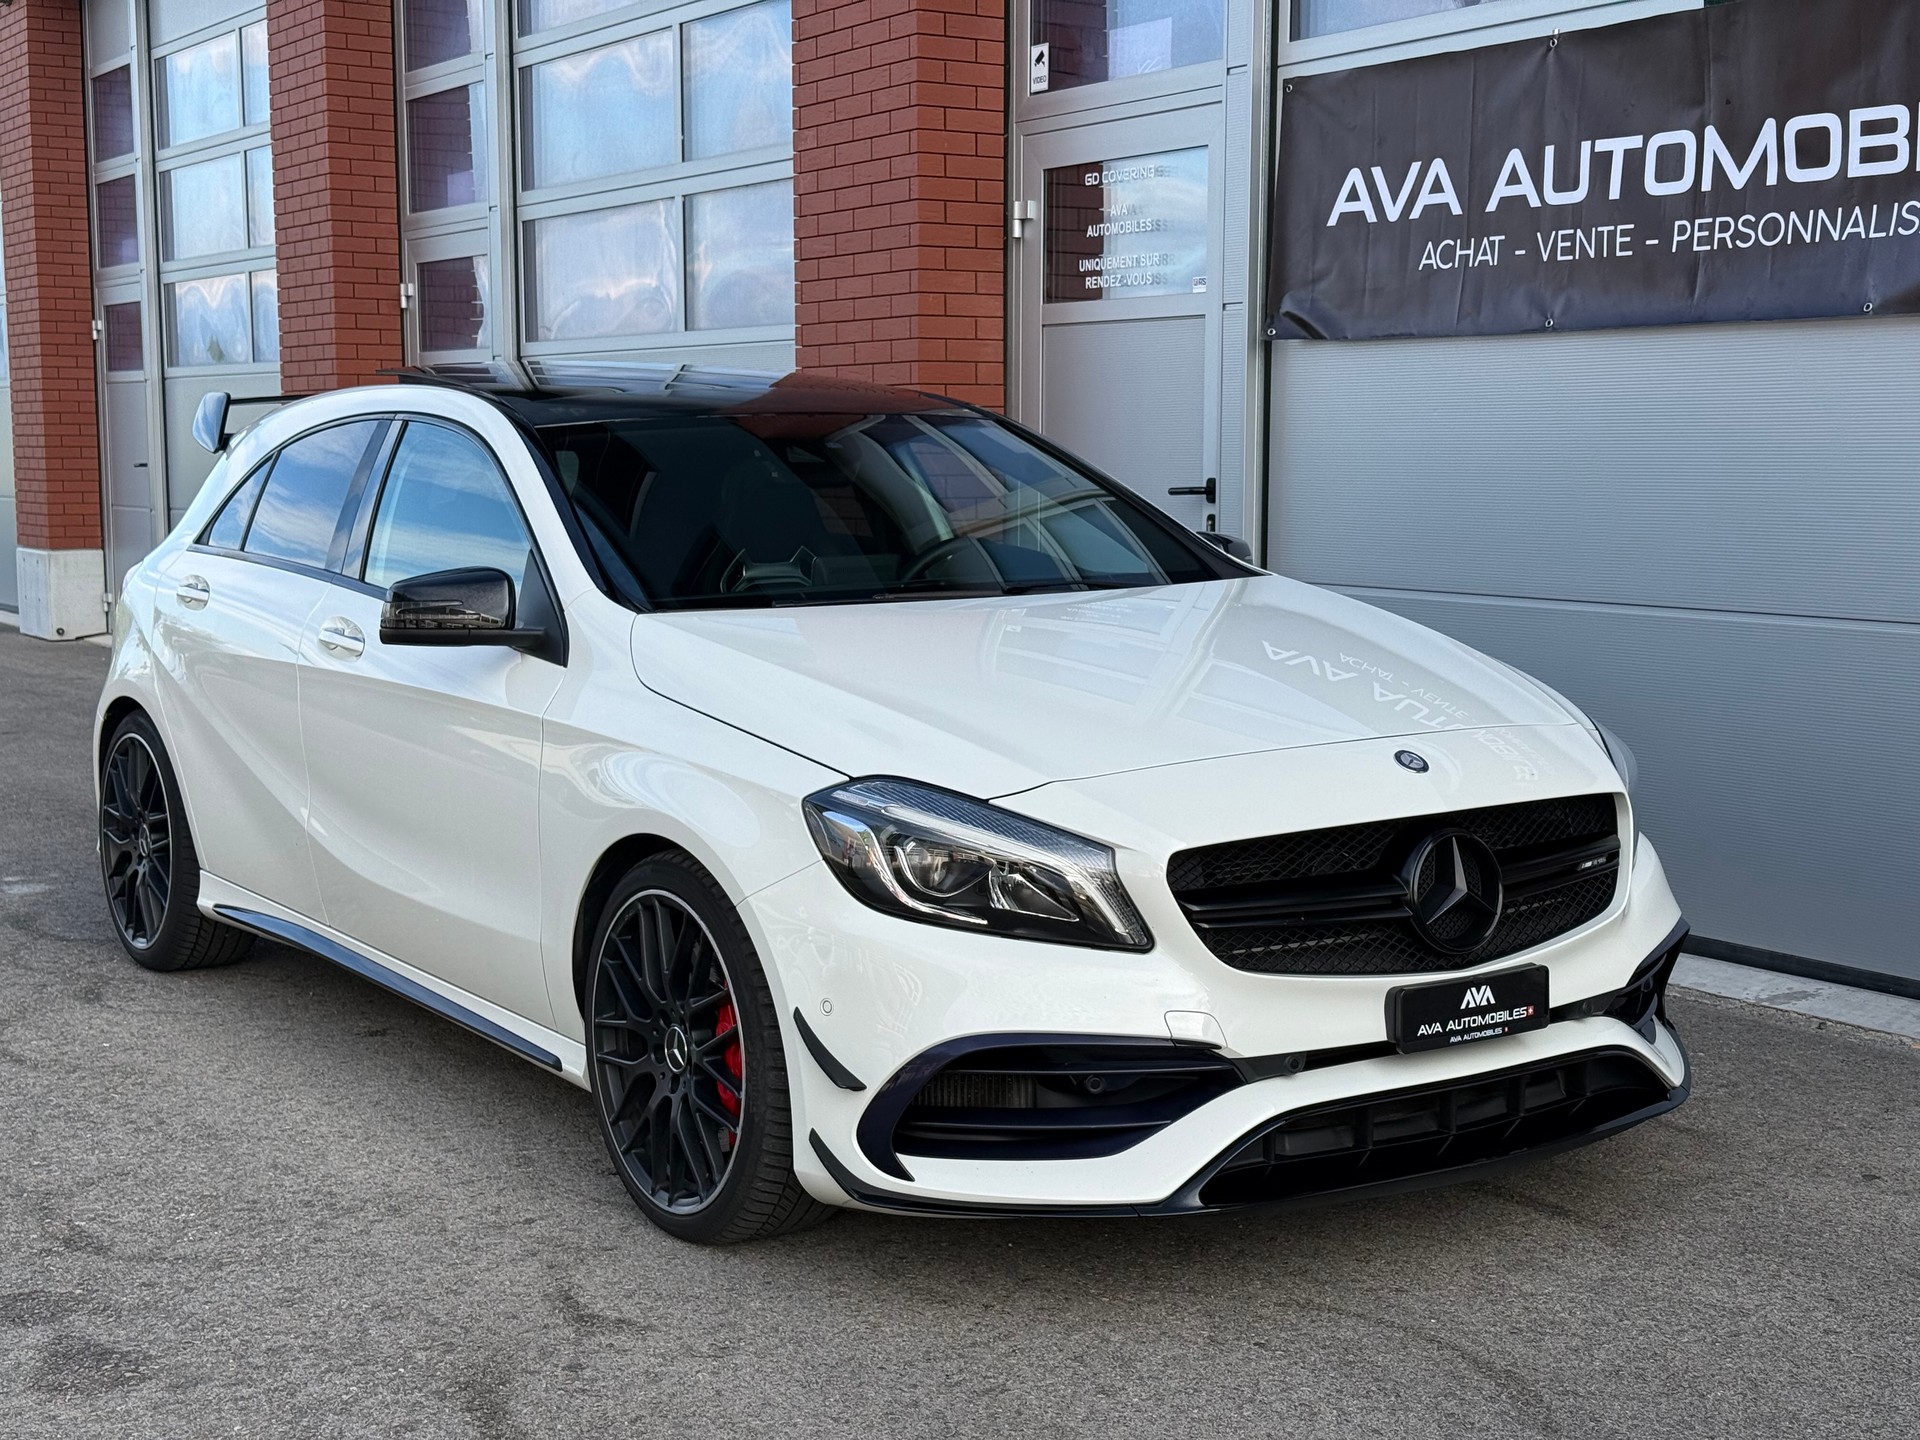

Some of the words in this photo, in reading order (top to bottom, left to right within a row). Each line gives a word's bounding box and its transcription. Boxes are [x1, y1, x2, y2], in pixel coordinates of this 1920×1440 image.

[1032, 75, 1047, 85] VIDEO
[1084, 172, 1100, 186] GD
[1101, 164, 1155, 184] COVERING
[1326, 157, 1463, 227] AVA
[1109, 203, 1128, 218] AVA
[1086, 218, 1152, 238] AUTOMOBILES
[1418, 234, 1505, 271] ACHAT
[1536, 223, 1635, 262] VENTE
[1079, 254, 1138, 272] UNIQUEMENT
[1140, 252, 1160, 266] SUR
[1460, 984, 1496, 1010] AVA
[1417, 1022, 1443, 1037] AVA
[1445, 1006, 1528, 1032] AUTOMOBILES
[1449, 1034, 1462, 1043] AVA
[1463, 1026, 1503, 1041] AUTOMOBILES
